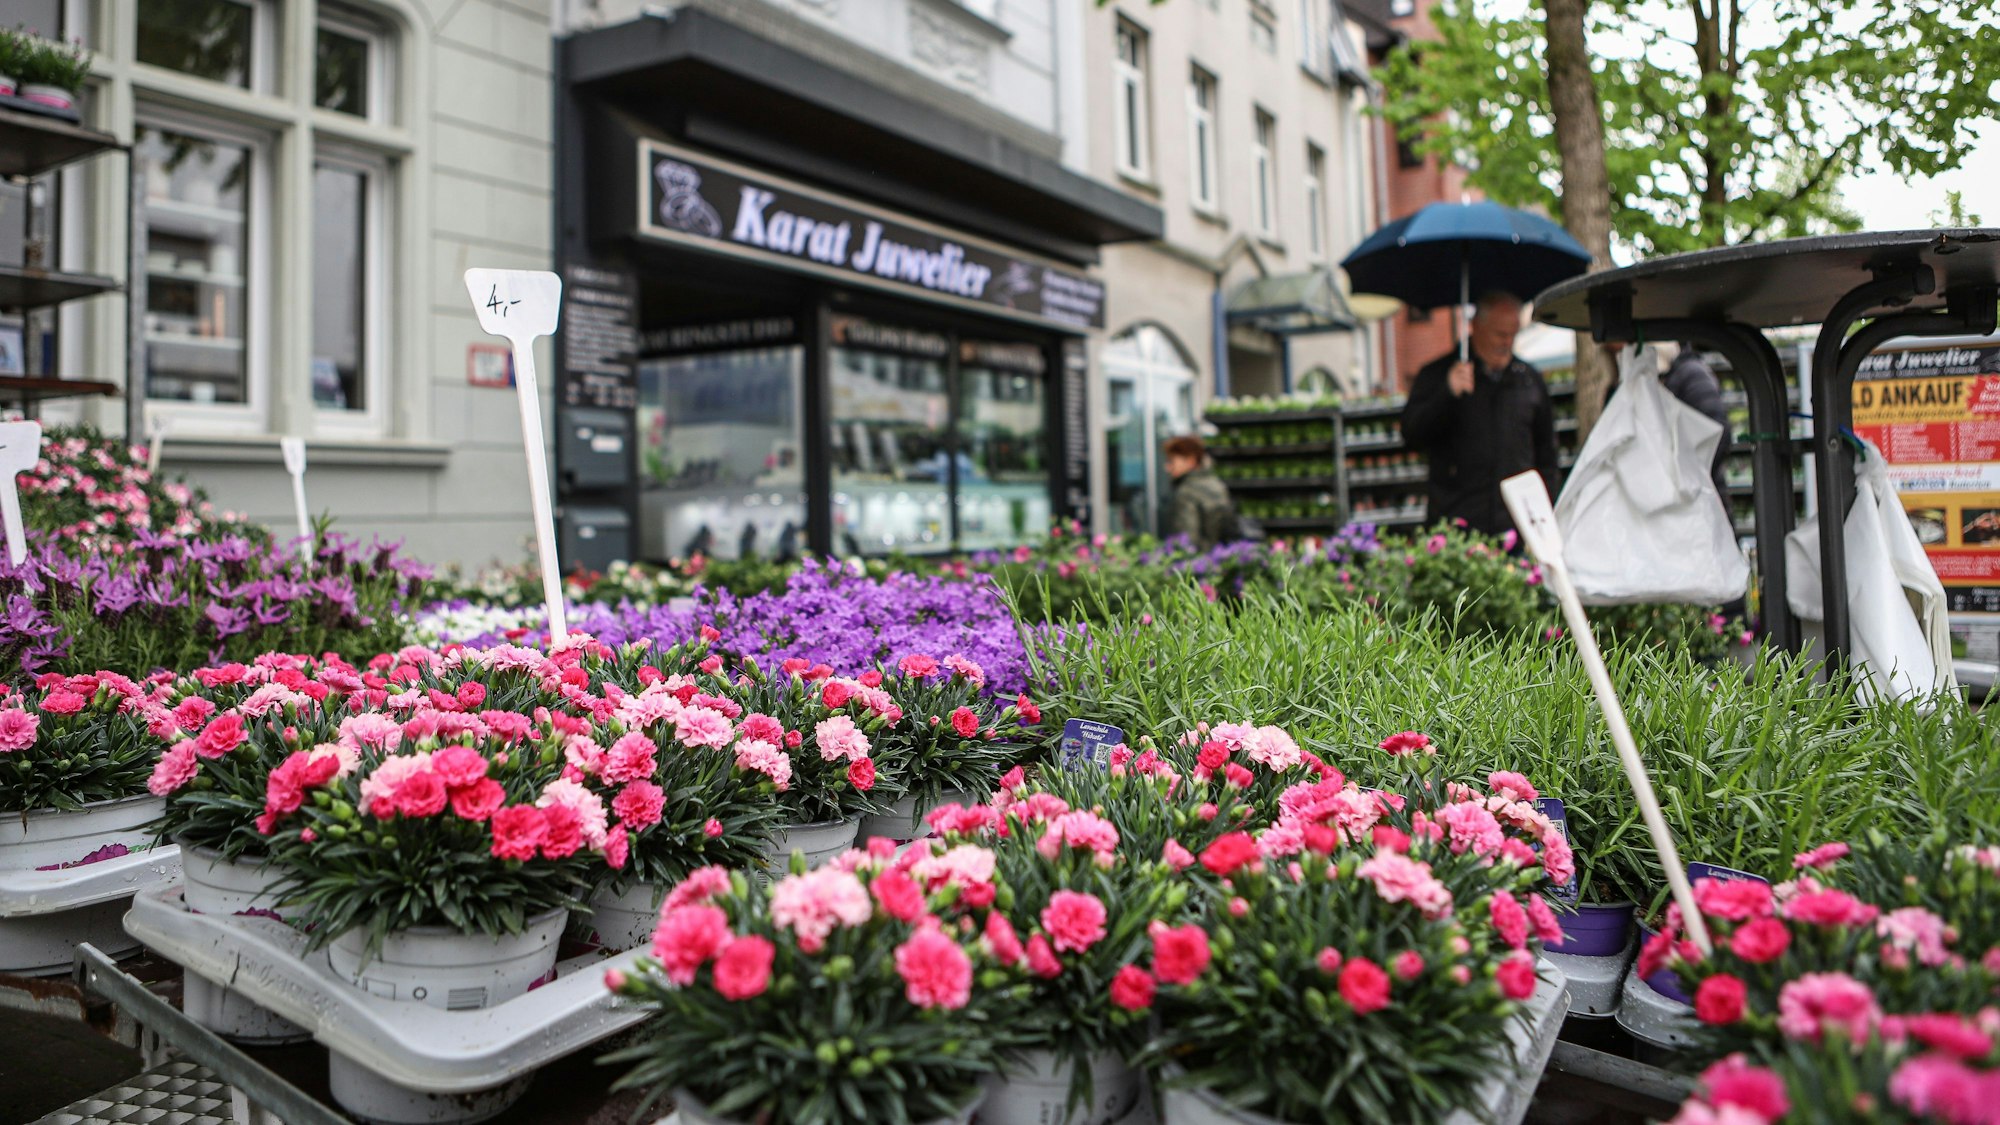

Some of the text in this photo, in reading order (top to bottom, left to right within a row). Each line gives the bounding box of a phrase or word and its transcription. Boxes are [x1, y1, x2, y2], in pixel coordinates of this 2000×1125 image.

[732, 186, 992, 297] Karat Juwelier
[1894, 347, 1981, 370] Juwelier
[1881, 381, 1963, 407] ANKAUF
